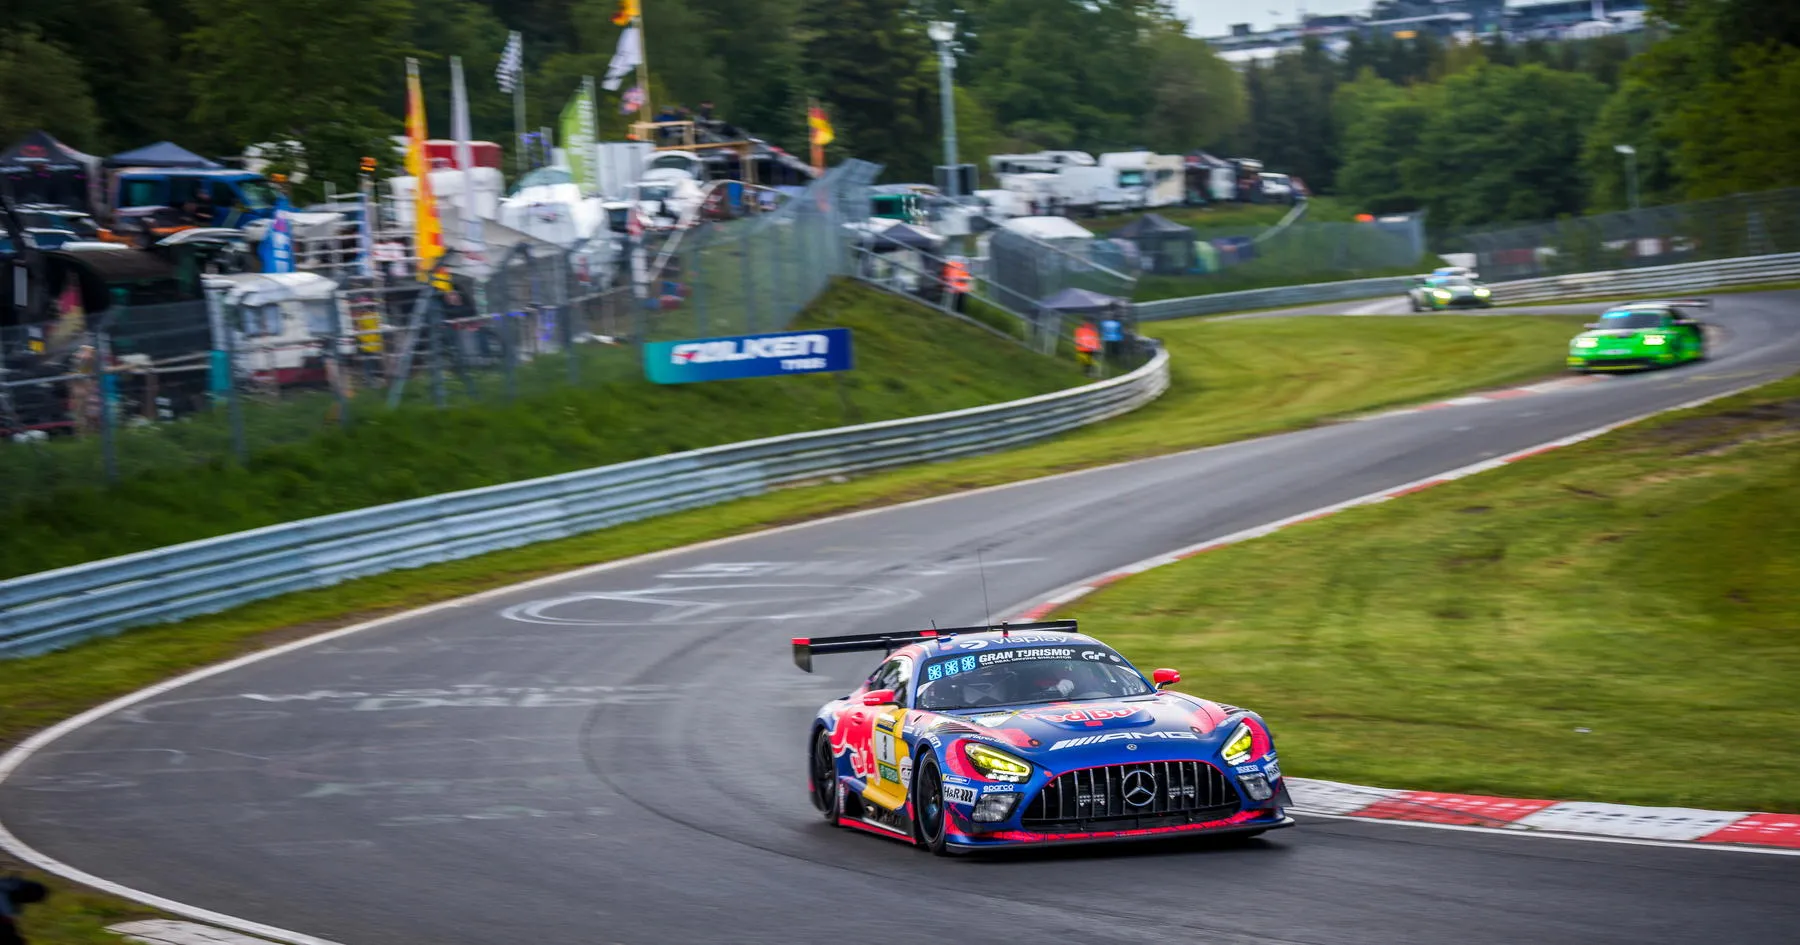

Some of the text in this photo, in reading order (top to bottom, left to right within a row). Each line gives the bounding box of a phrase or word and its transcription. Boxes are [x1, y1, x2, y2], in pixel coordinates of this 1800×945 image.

[671, 334, 829, 364] FALKEN
[992, 635, 1068, 645] viaplay
[979, 651, 1013, 663] GRAN
